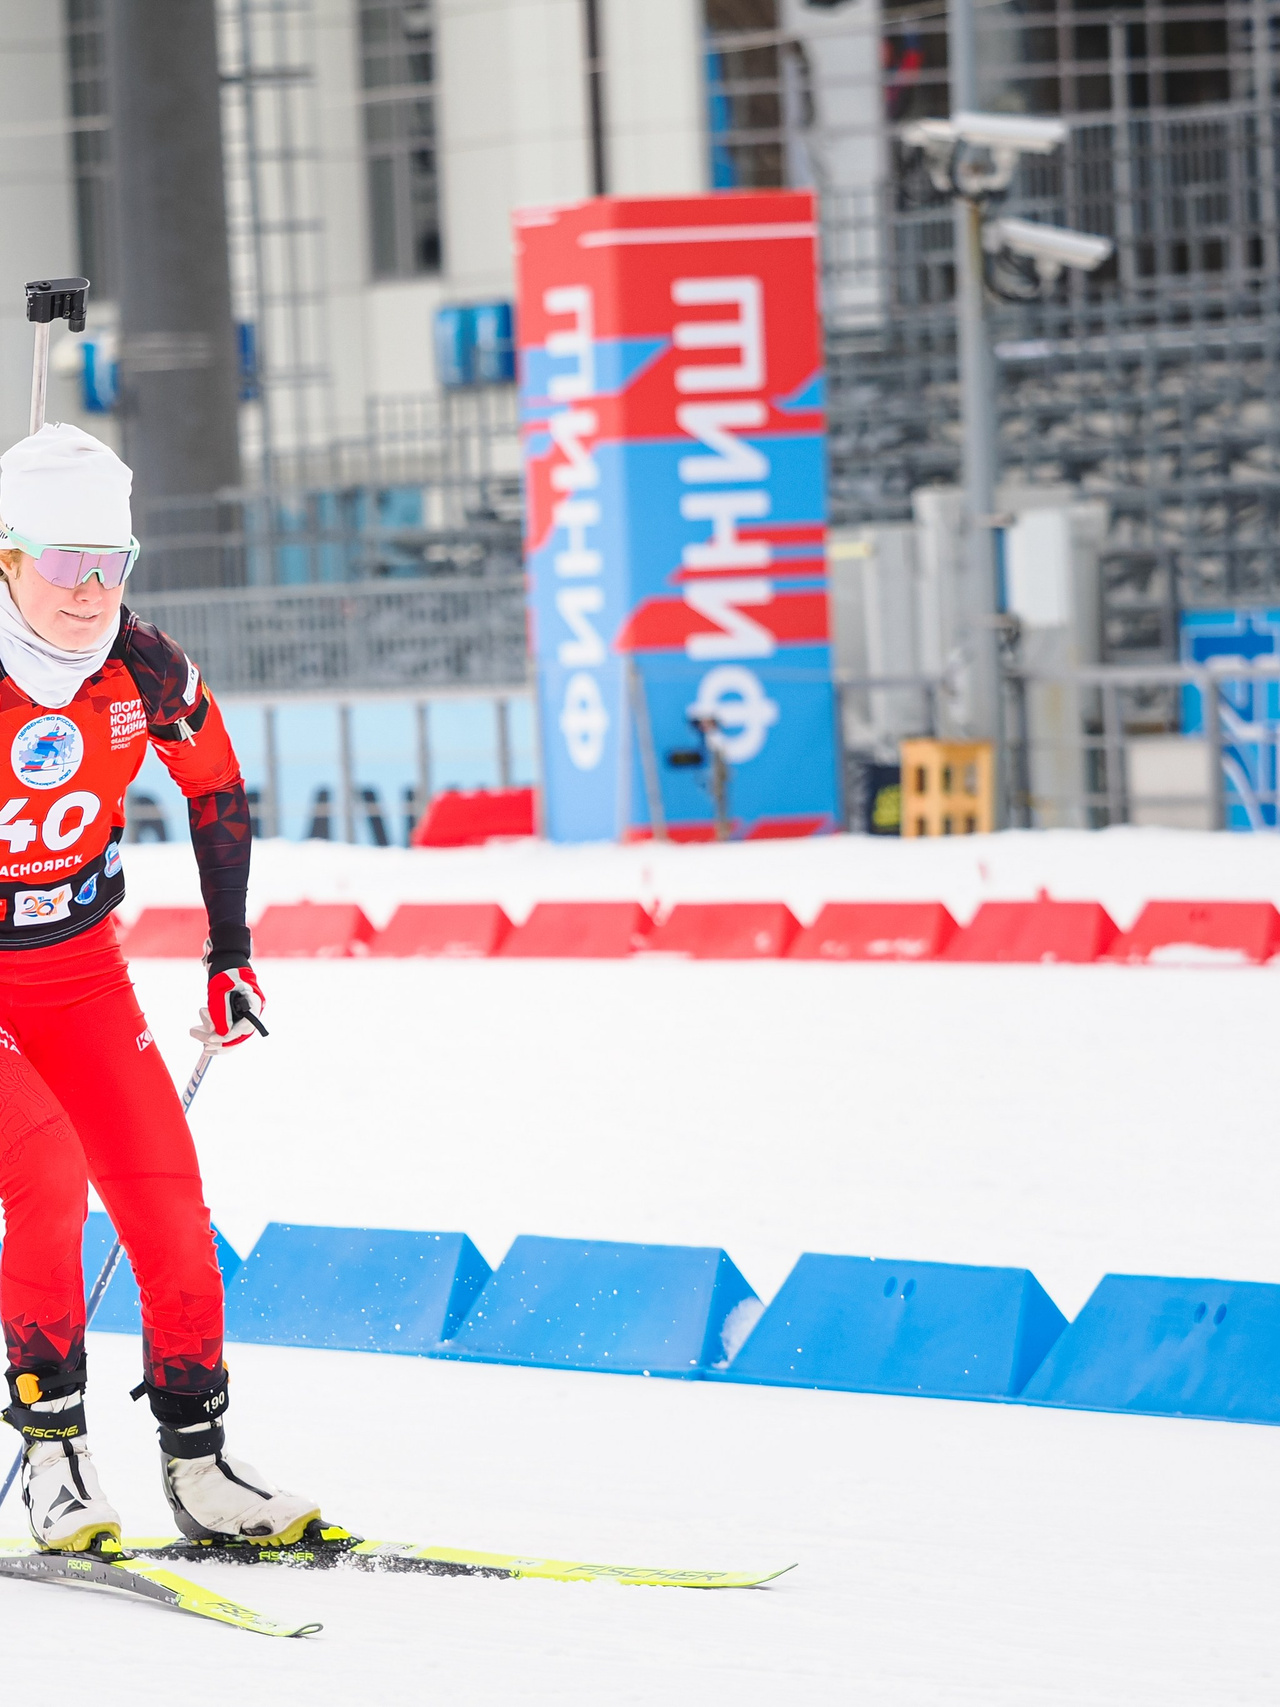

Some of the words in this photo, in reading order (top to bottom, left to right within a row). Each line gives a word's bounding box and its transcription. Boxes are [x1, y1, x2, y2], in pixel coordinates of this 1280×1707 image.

[542, 284, 609, 771] ФИНИШ
[670, 276, 778, 764] ФИНИШ
[111, 719, 147, 738] ЖИЗНИ
[202, 1391, 226, 1414] 190
[22, 1424, 79, 1439] FISCHE
[67, 1559, 93, 1572] FISCHER
[258, 1550, 315, 1562] FISCHER
[566, 1564, 728, 1583] FISCHER
